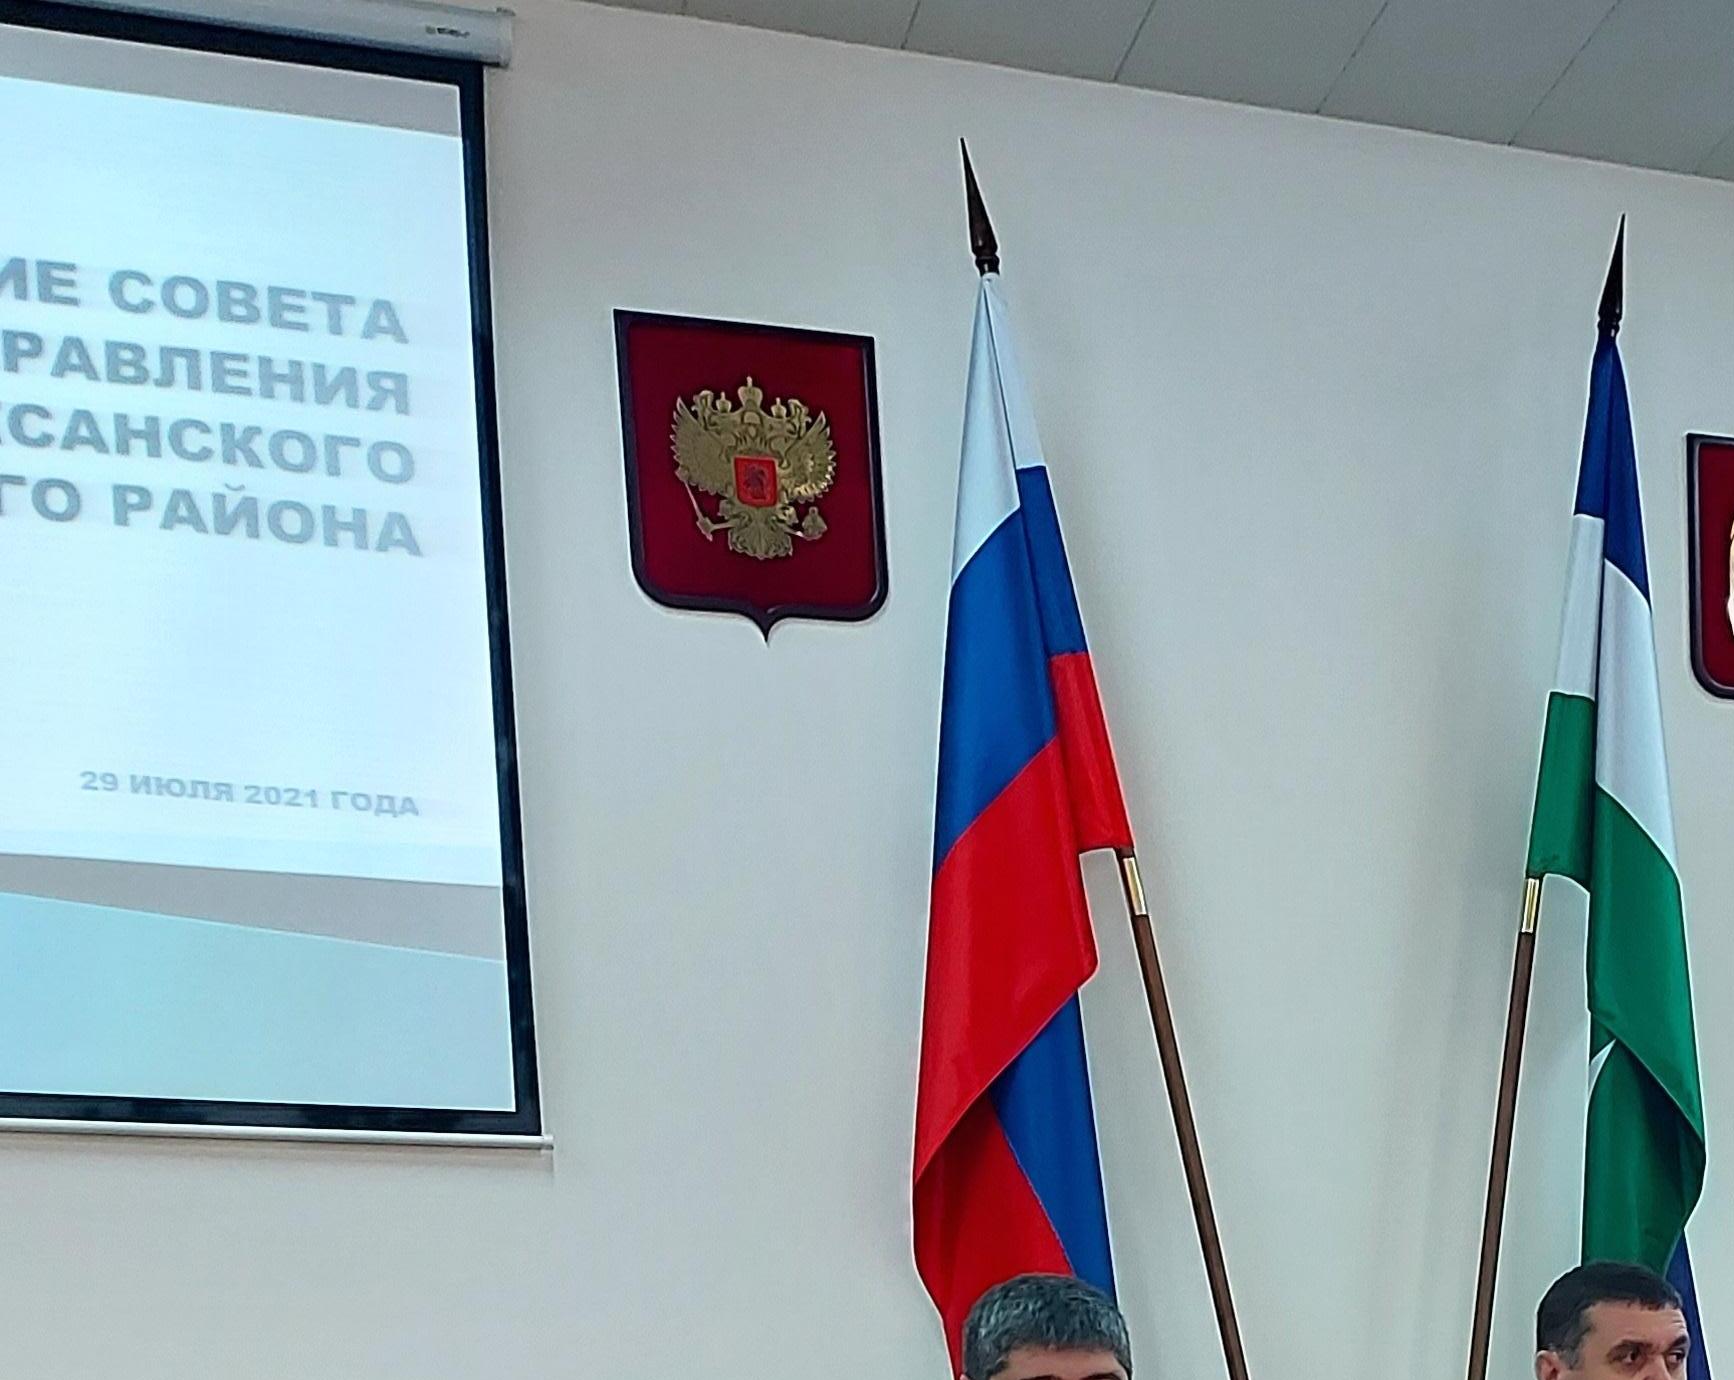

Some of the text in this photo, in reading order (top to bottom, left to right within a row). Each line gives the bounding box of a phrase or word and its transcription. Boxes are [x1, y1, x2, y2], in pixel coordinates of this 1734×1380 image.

[108, 269, 409, 344] СОВЕТА
[2, 329, 411, 415] РАВЛЕНИЯ
[0, 403, 415, 484] САНСКОГО
[112, 483, 423, 557] РАЙОНА
[80, 770, 420, 818] 29 ИЮЛЯ 2021 ГОДА
